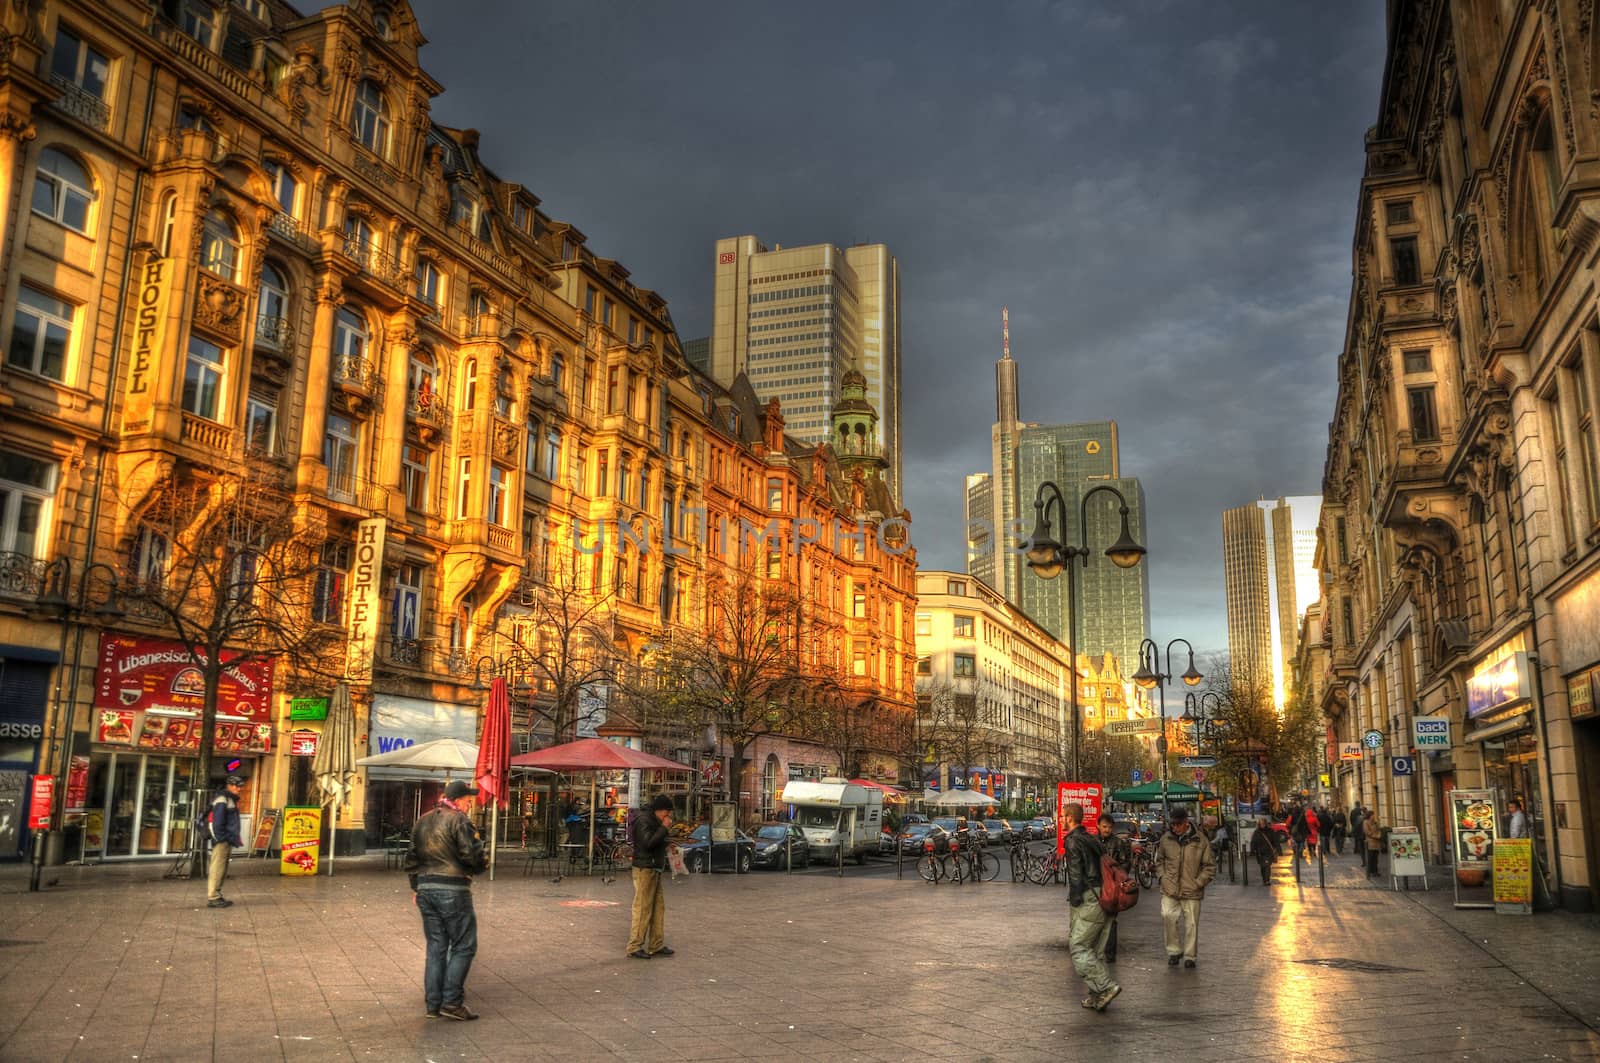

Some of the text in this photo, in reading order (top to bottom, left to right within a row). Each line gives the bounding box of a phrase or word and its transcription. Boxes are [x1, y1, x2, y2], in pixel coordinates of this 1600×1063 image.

[721, 254, 734, 263] DB
[129, 263, 165, 394] HOSTEL
[352, 525, 377, 642] HOSTEL
[1418, 721, 1446, 732] back
[1417, 735, 1448, 745] WERK
[1344, 745, 1360, 755] dm
